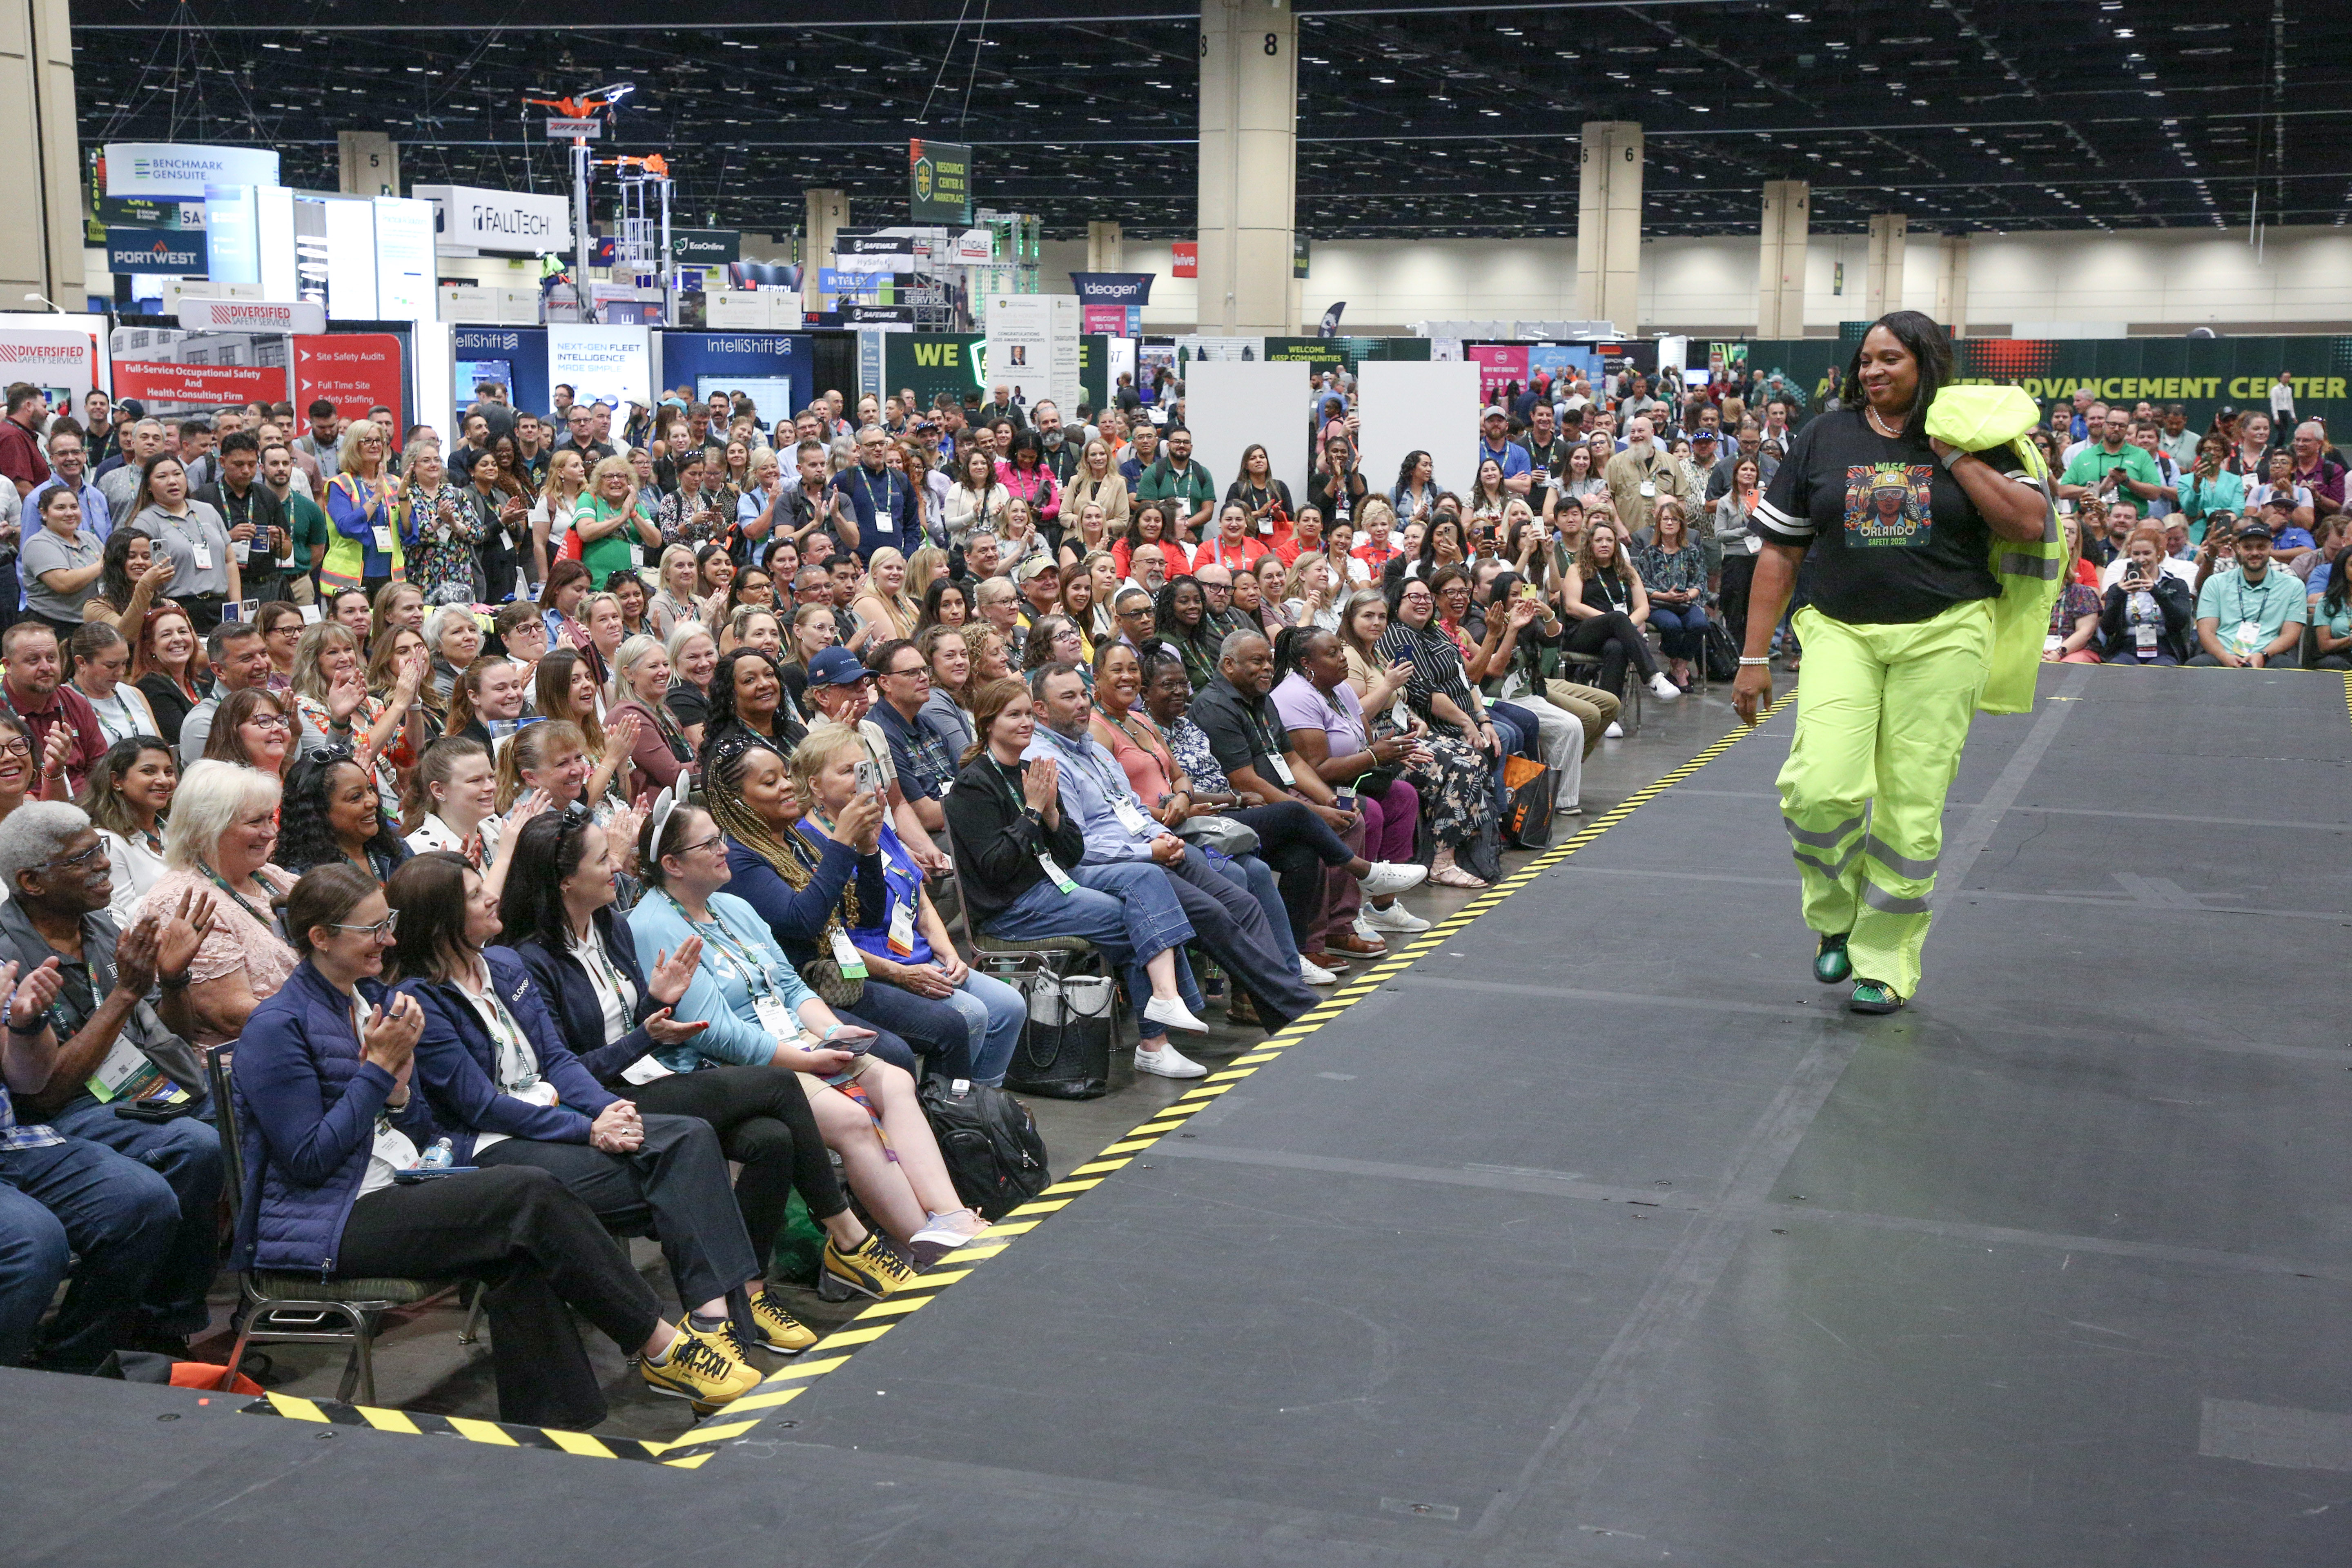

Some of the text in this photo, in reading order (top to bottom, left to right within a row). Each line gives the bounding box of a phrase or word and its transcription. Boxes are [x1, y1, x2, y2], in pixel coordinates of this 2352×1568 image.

[1201, 34, 1207, 57] 8
[1264, 33, 1278, 56] 8
[370, 154, 379, 167] 5
[1582, 148, 1588, 163] 6
[1626, 147, 1634, 162] 6
[153, 158, 223, 170] BENCHMARK
[936, 161, 964, 175] RESOURCE
[153, 170, 207, 180] GENSUITE
[1797, 198, 1804, 208] 4
[832, 205, 838, 216] 3
[1110, 234, 1114, 243] 1
[689, 242, 725, 251] EcoOnline
[114, 251, 196, 265] PORTWEST
[1084, 282, 1137, 298] Ideagen
[231, 305, 290, 319] DIVERSIFIED
[231, 316, 291, 327] SAFETY SERVICES
[18, 345, 83, 357] DIVERSIFIED
[557, 343, 607, 351] NEXT-GEN
[707, 338, 773, 353] IntelliShift
[47, 356, 82, 365] SERVICES
[316, 352, 385, 363] Site Safety Audits
[557, 354, 626, 362] INTELLIGENCE
[914, 343, 958, 367] WE
[125, 363, 261, 380] Full-Service Occupational Safety
[588, 364, 622, 372] SIMPLE
[184, 379, 203, 388] And
[318, 381, 370, 390] Full Time Site
[2021, 376, 2222, 400] DVANCEMENT
[147, 388, 243, 402] Health Consulting Firm
[345, 394, 374, 405] Staffing
[1875, 462, 1907, 472] WISE
[1860, 526, 1915, 537] ORLANDO
[1868, 537, 1907, 546] SAFETY 2025
[484, 850, 493, 865] Avetta
[368, 855, 381, 875] SAFETY25
[234, 893, 250, 909] Avetta
[693, 921, 707, 935] Avetta
[717, 917, 731, 935] SAFETY25
[733, 962, 749, 981] SAFETY25
[512, 977, 529, 1002] ELOKO
[55, 1009, 67, 1029] Avetta
[621, 1001, 630, 1024] SAFETY25
